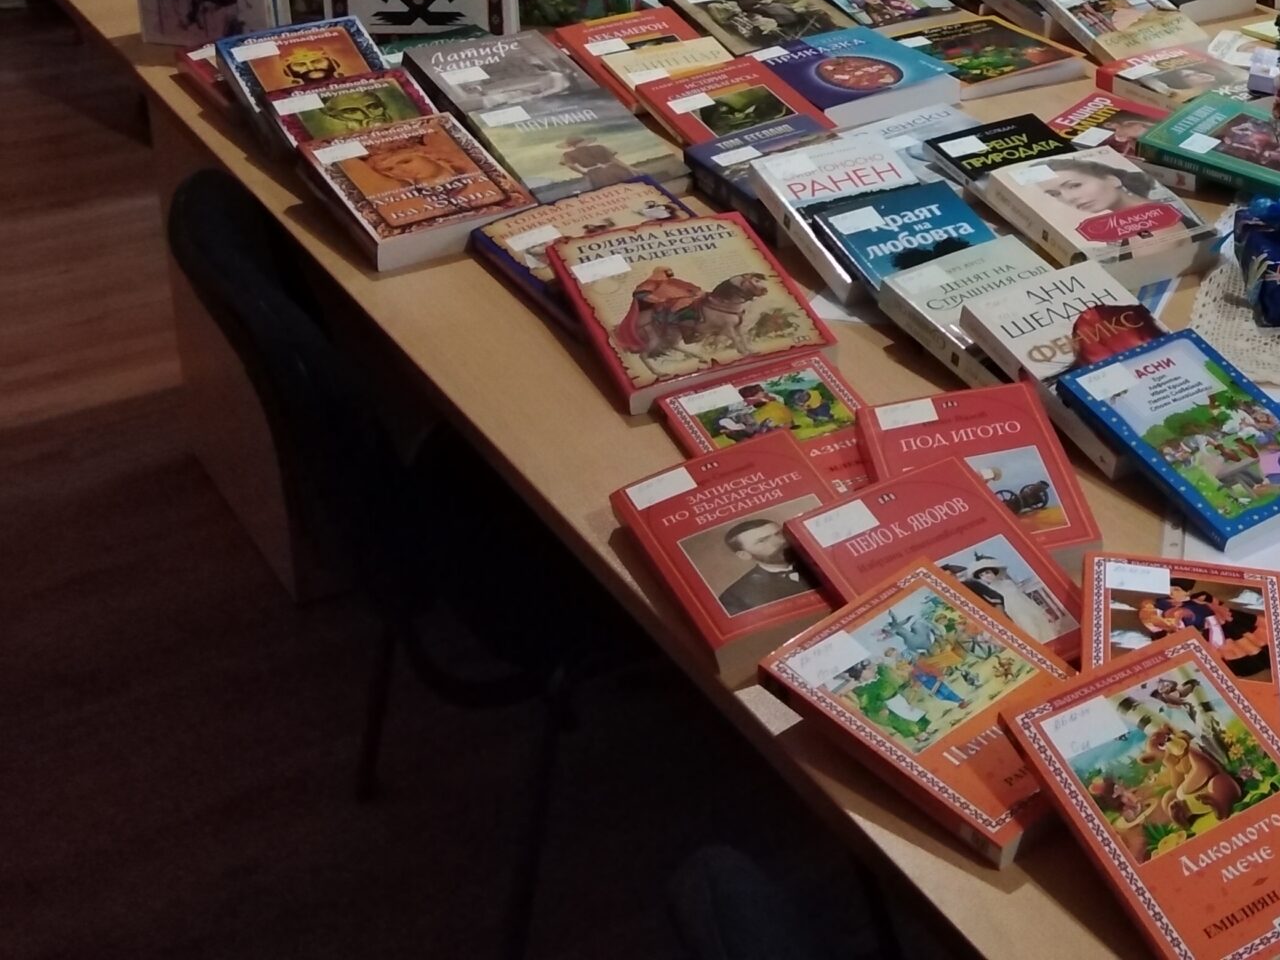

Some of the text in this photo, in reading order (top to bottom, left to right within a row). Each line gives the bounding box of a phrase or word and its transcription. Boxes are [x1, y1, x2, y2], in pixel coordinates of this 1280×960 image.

[430, 40, 521, 65] Латифе
[765, 37, 866, 67] ПРИКАЗКА
[514, 108, 599, 132] ПАУЛИНА
[1055, 97, 1113, 126] Елинор
[1058, 106, 1121, 139] Смит
[961, 138, 1065, 171] ПРИРОДАТА
[787, 161, 903, 201] РАНЕН
[504, 185, 633, 229] ГОЛЯМА КНИГА
[575, 222, 728, 255] ГОЛЯМА КНИГА
[866, 220, 977, 261] любовта
[913, 219, 933, 233] на
[608, 230, 738, 257] БЪЛГАРСКИТЕ
[622, 242, 719, 265] ЛАДЕТЕЛИ
[925, 264, 1049, 313] СТРАШНИЯ СЪД
[938, 262, 1017, 294] ДЕНЯТ НА
[1023, 275, 1089, 306] ДНИ
[999, 288, 1120, 340] ШЕЛДЪН
[1025, 310, 1146, 365] ФЕНИКС
[1133, 356, 1177, 380] АСНИ
[900, 419, 1022, 455] ПОД ИГОТО
[661, 470, 803, 528] ПО БЪЛГАРСКИТЕ
[686, 471, 766, 506] ЗАПИСКИ
[694, 488, 785, 525] ВЪСТАНИЯ
[845, 526, 896, 558] ПЕЙО
[910, 496, 971, 534] ЯВОРОВ
[1218, 844, 1277, 884] мече
